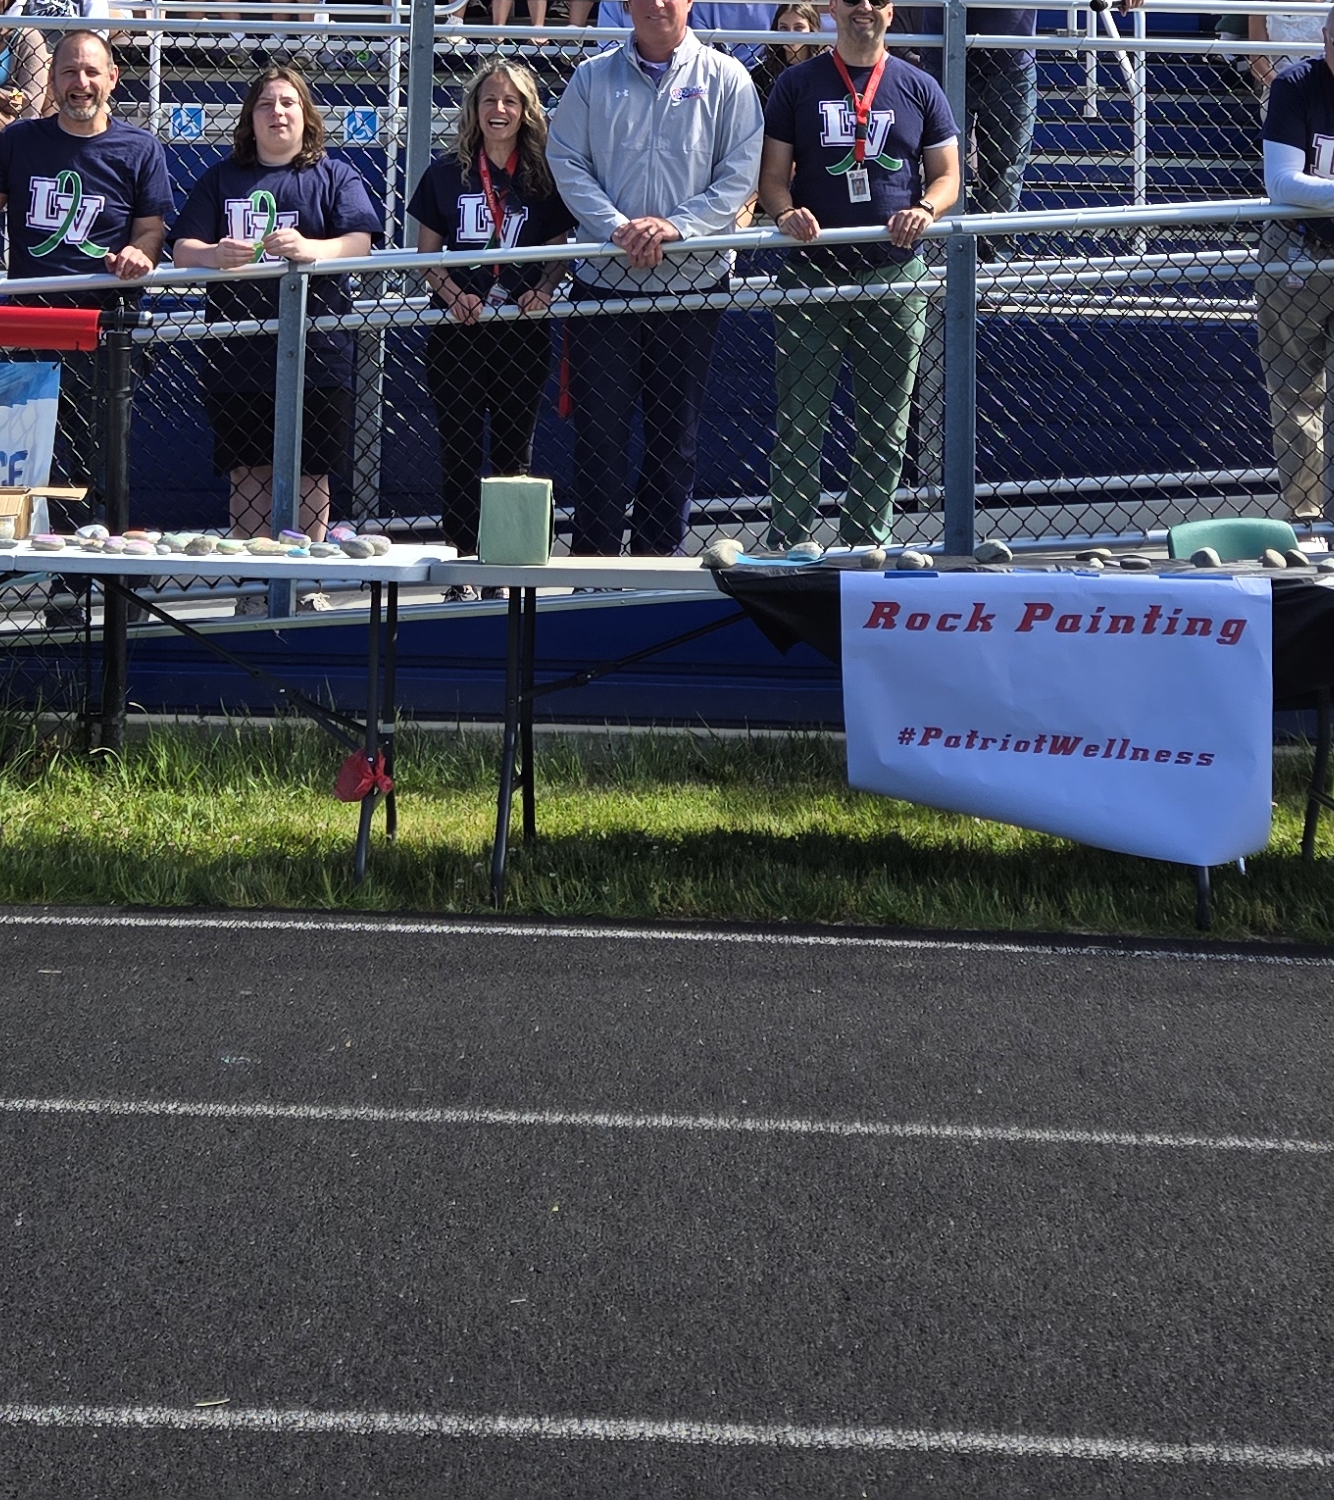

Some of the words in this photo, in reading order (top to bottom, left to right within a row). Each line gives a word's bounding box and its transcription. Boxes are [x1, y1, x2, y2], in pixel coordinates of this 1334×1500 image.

[818, 100, 896, 160] LV
[25, 175, 106, 244] LV
[862, 600, 997, 634] Rock
[1014, 602, 1249, 647] Painting
[897, 725, 1216, 768] #PatriotWellness
